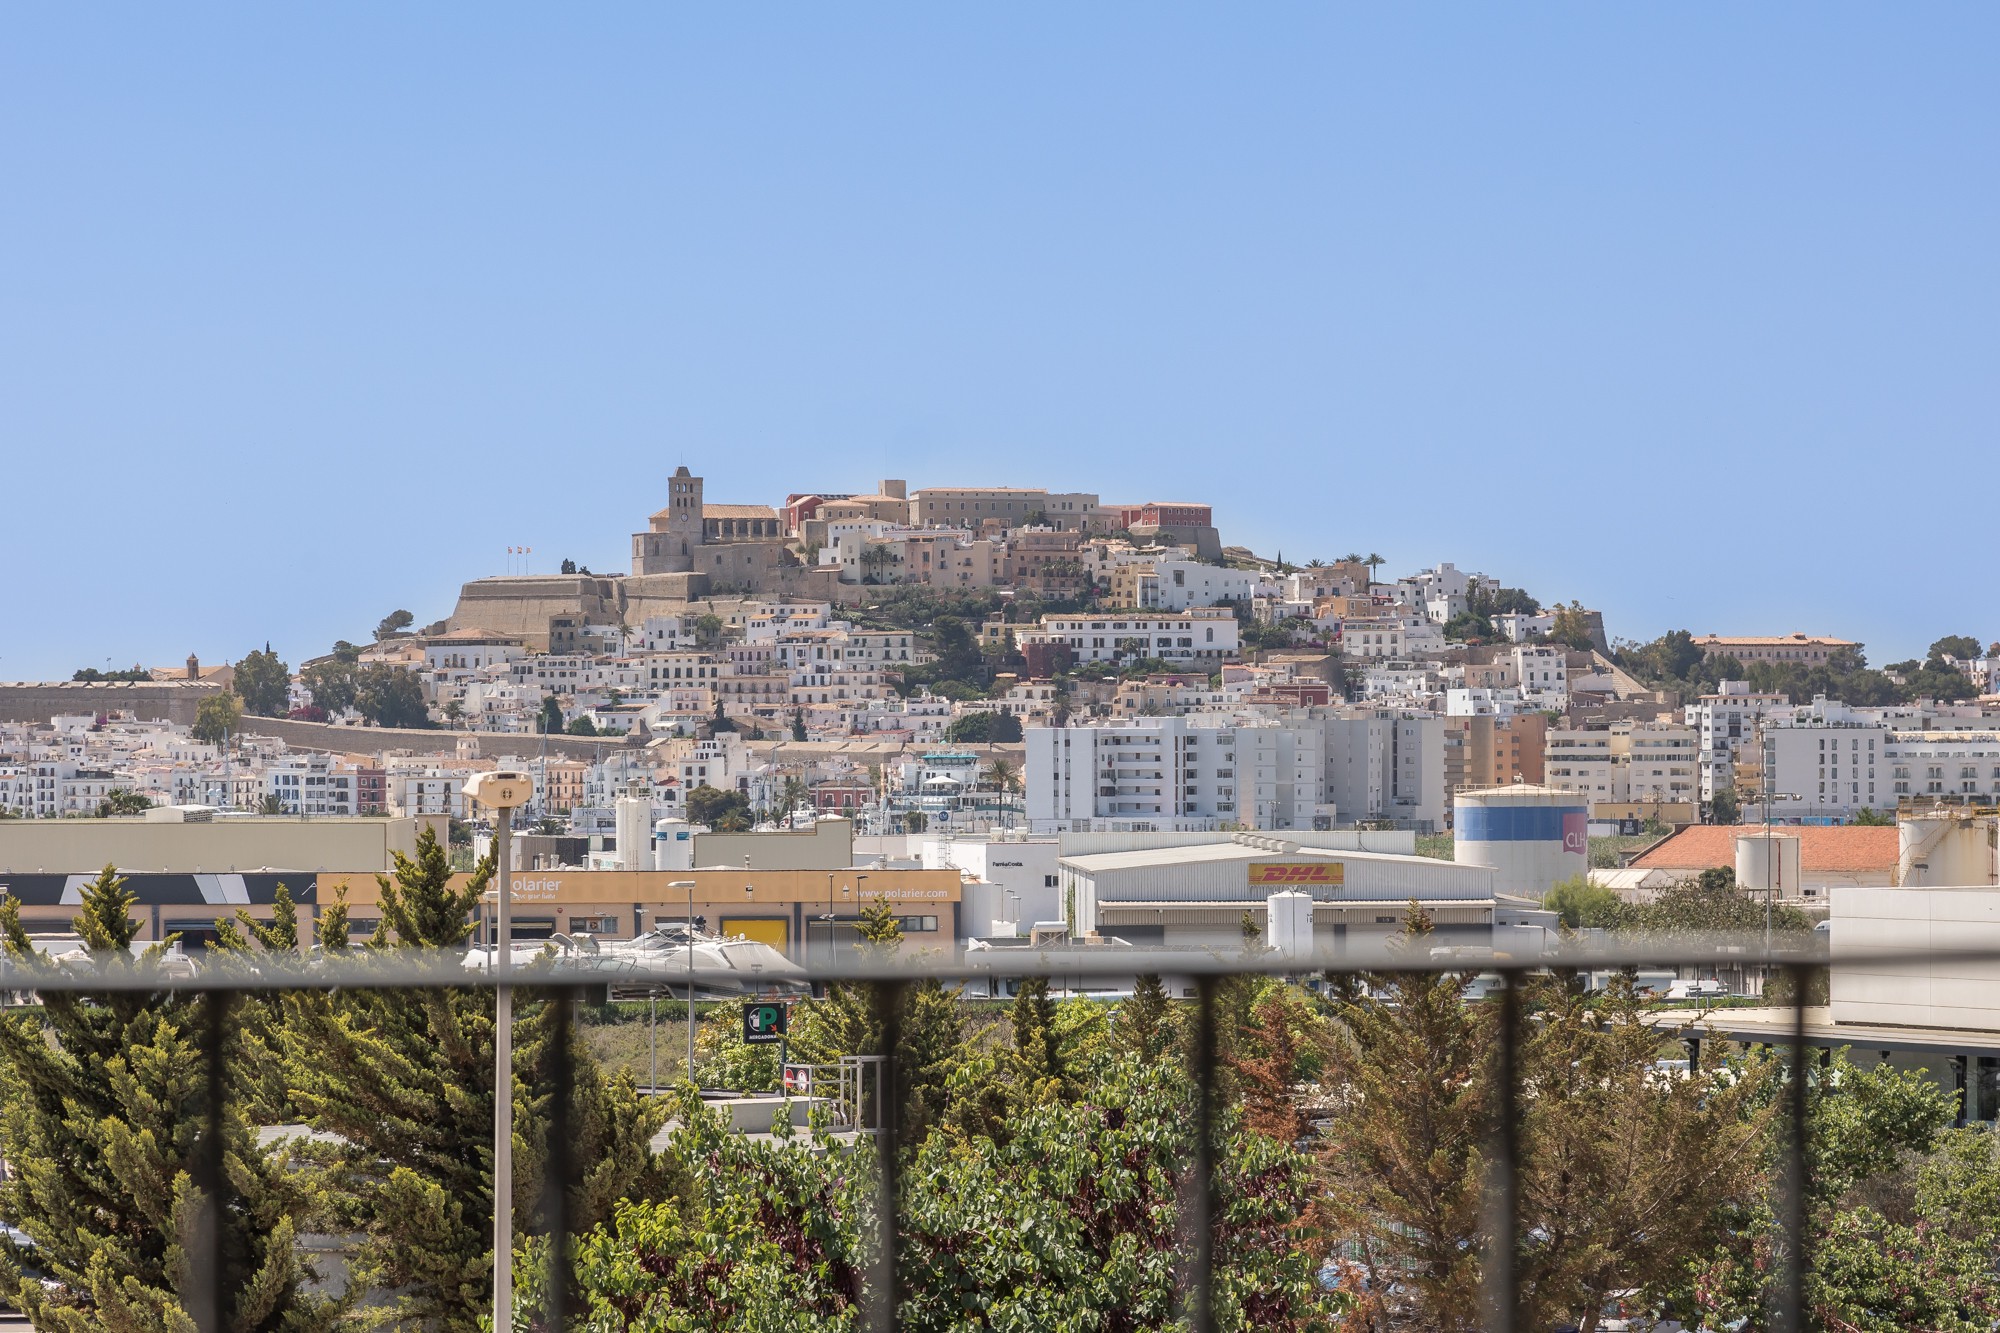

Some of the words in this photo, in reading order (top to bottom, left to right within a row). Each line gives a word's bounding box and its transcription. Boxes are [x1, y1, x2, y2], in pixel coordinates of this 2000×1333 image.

[1566, 832, 1586, 848] CLH
[1262, 866, 1330, 881] DHL
[511, 876, 562, 891] olarier
[759, 1007, 778, 1031] P
